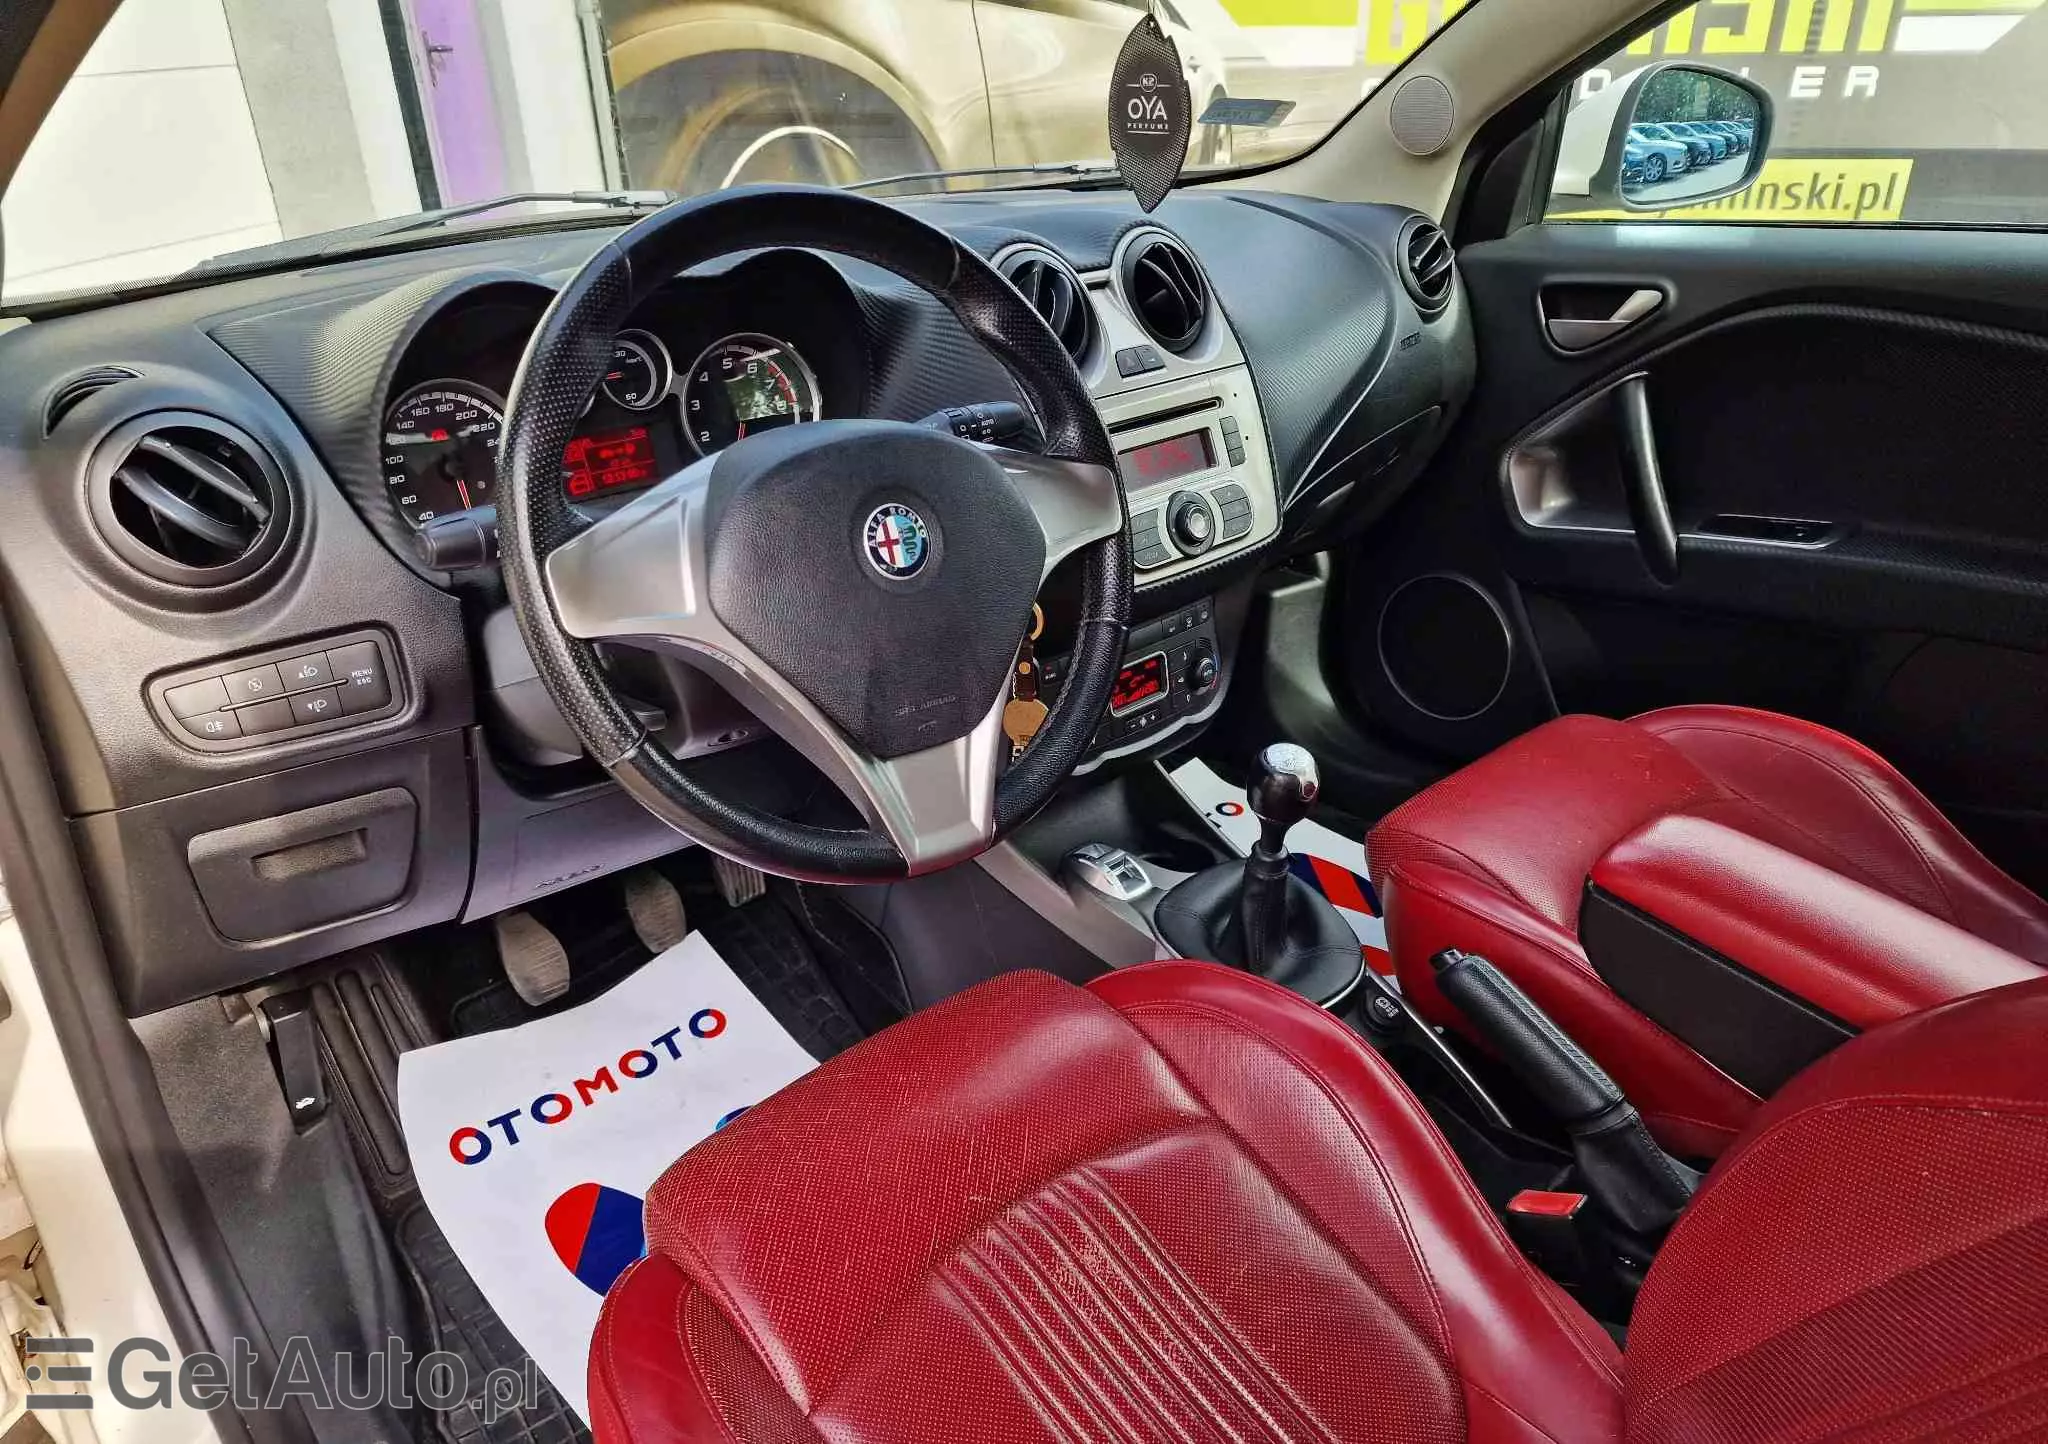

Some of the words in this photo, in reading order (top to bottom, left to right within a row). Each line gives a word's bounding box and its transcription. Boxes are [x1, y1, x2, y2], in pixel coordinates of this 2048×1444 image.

[1128, 95, 1168, 120] OYA
[1127, 122, 1169, 130] PERFUME
[722, 357, 733, 370] 5
[747, 362, 758, 374] 6
[699, 371, 709, 382] 4
[434, 402, 454, 413] 180
[690, 399, 701, 411] 3
[410, 406, 431, 417] 160
[455, 409, 478, 421] 200
[396, 420, 415, 430] 140
[472, 421, 496, 433] 220
[700, 430, 710, 442] 2
[385, 454, 404, 465] 100
[389, 474, 405, 485] 80
[401, 494, 417, 505] 60
[418, 510, 434, 521] 40
[867, 512, 886, 548] ALFA
[351, 667, 373, 679] MENU
[449, 1008, 727, 1165] OTOMOTO
